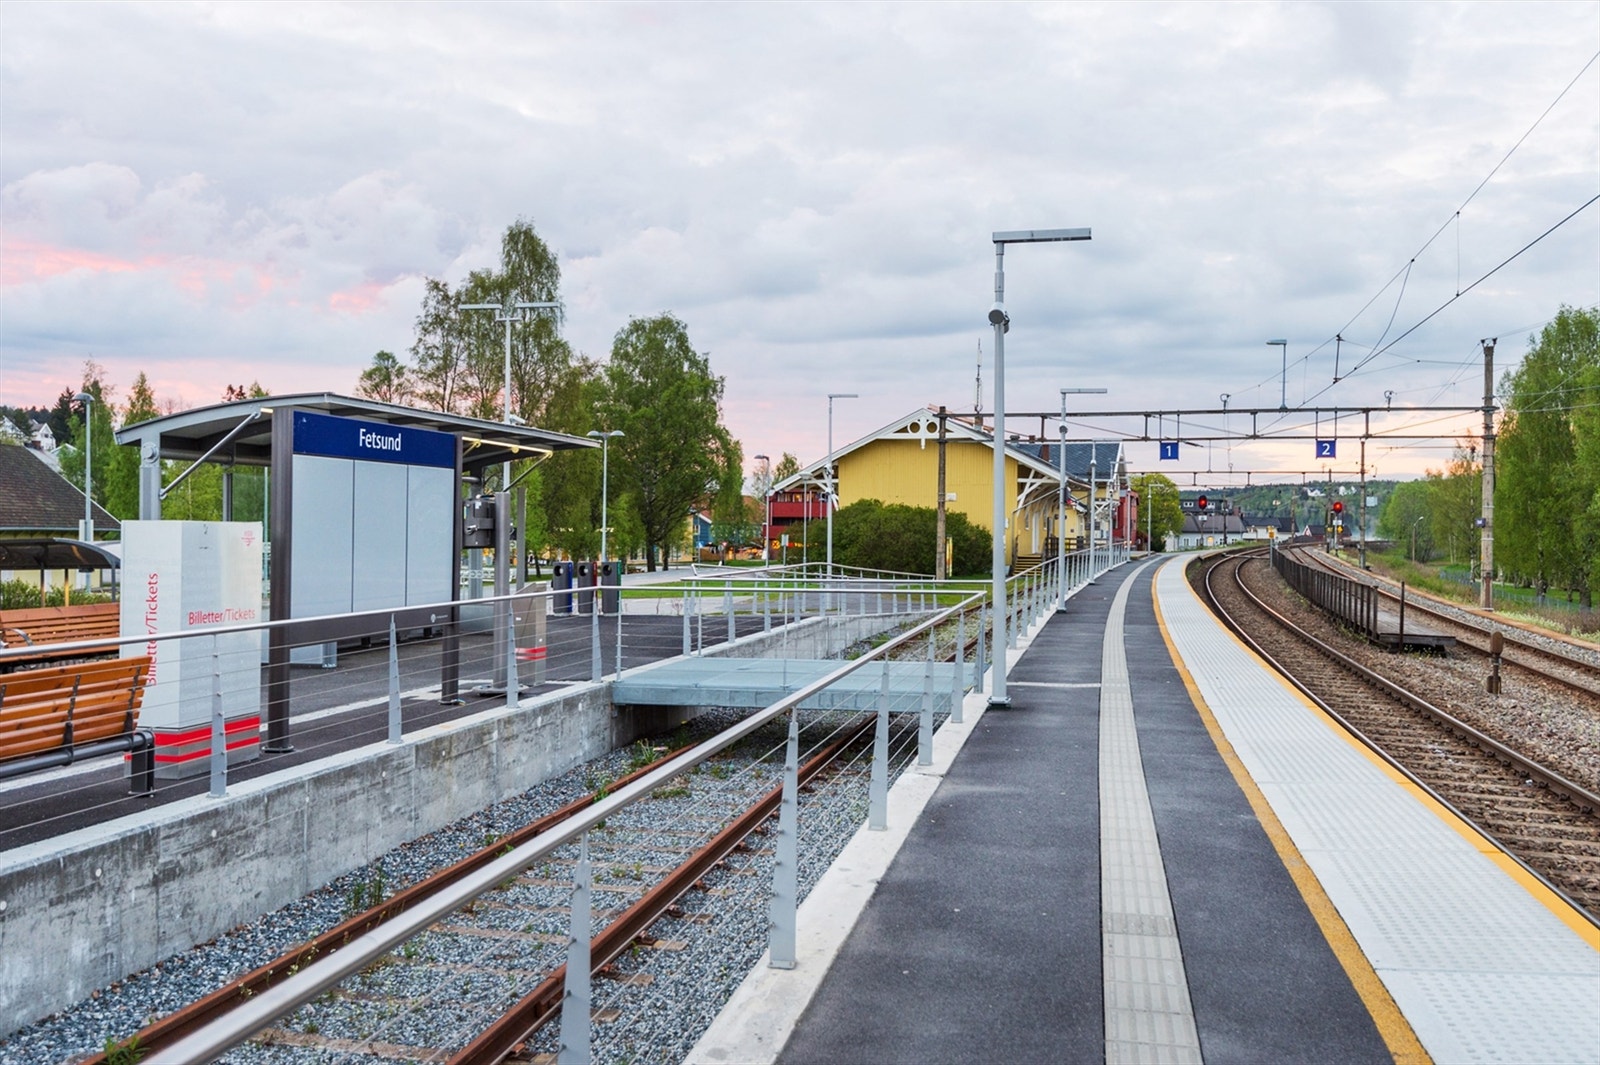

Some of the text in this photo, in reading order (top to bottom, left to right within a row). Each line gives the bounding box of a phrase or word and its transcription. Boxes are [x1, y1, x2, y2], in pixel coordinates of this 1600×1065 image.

[359, 428, 402, 451] Fetsund
[1165, 445, 1171, 457] 1
[1321, 443, 1331, 455] 2
[188, 608, 256, 625] Billetter/Tickets
